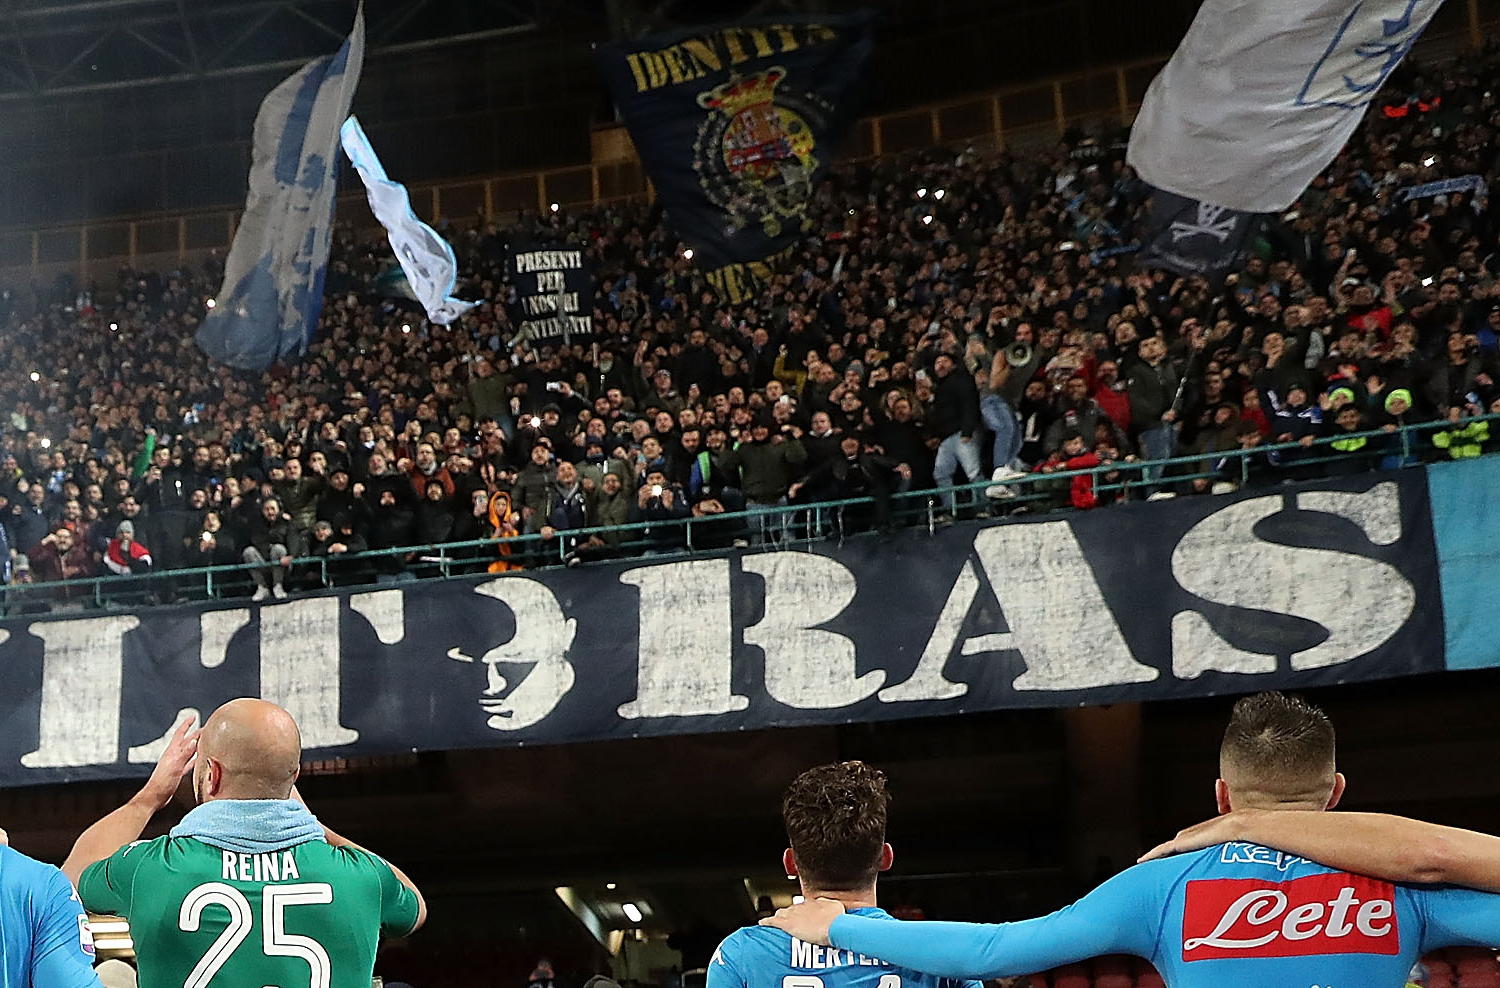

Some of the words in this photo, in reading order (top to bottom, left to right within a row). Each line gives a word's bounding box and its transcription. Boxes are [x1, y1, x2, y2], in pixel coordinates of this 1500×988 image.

[516, 250, 582, 273] PRESENTI
[536, 270, 566, 292] PER
[222, 850, 300, 881] REINA
[1220, 842, 1312, 871] Kap
[1184, 888, 1393, 951] Lete
